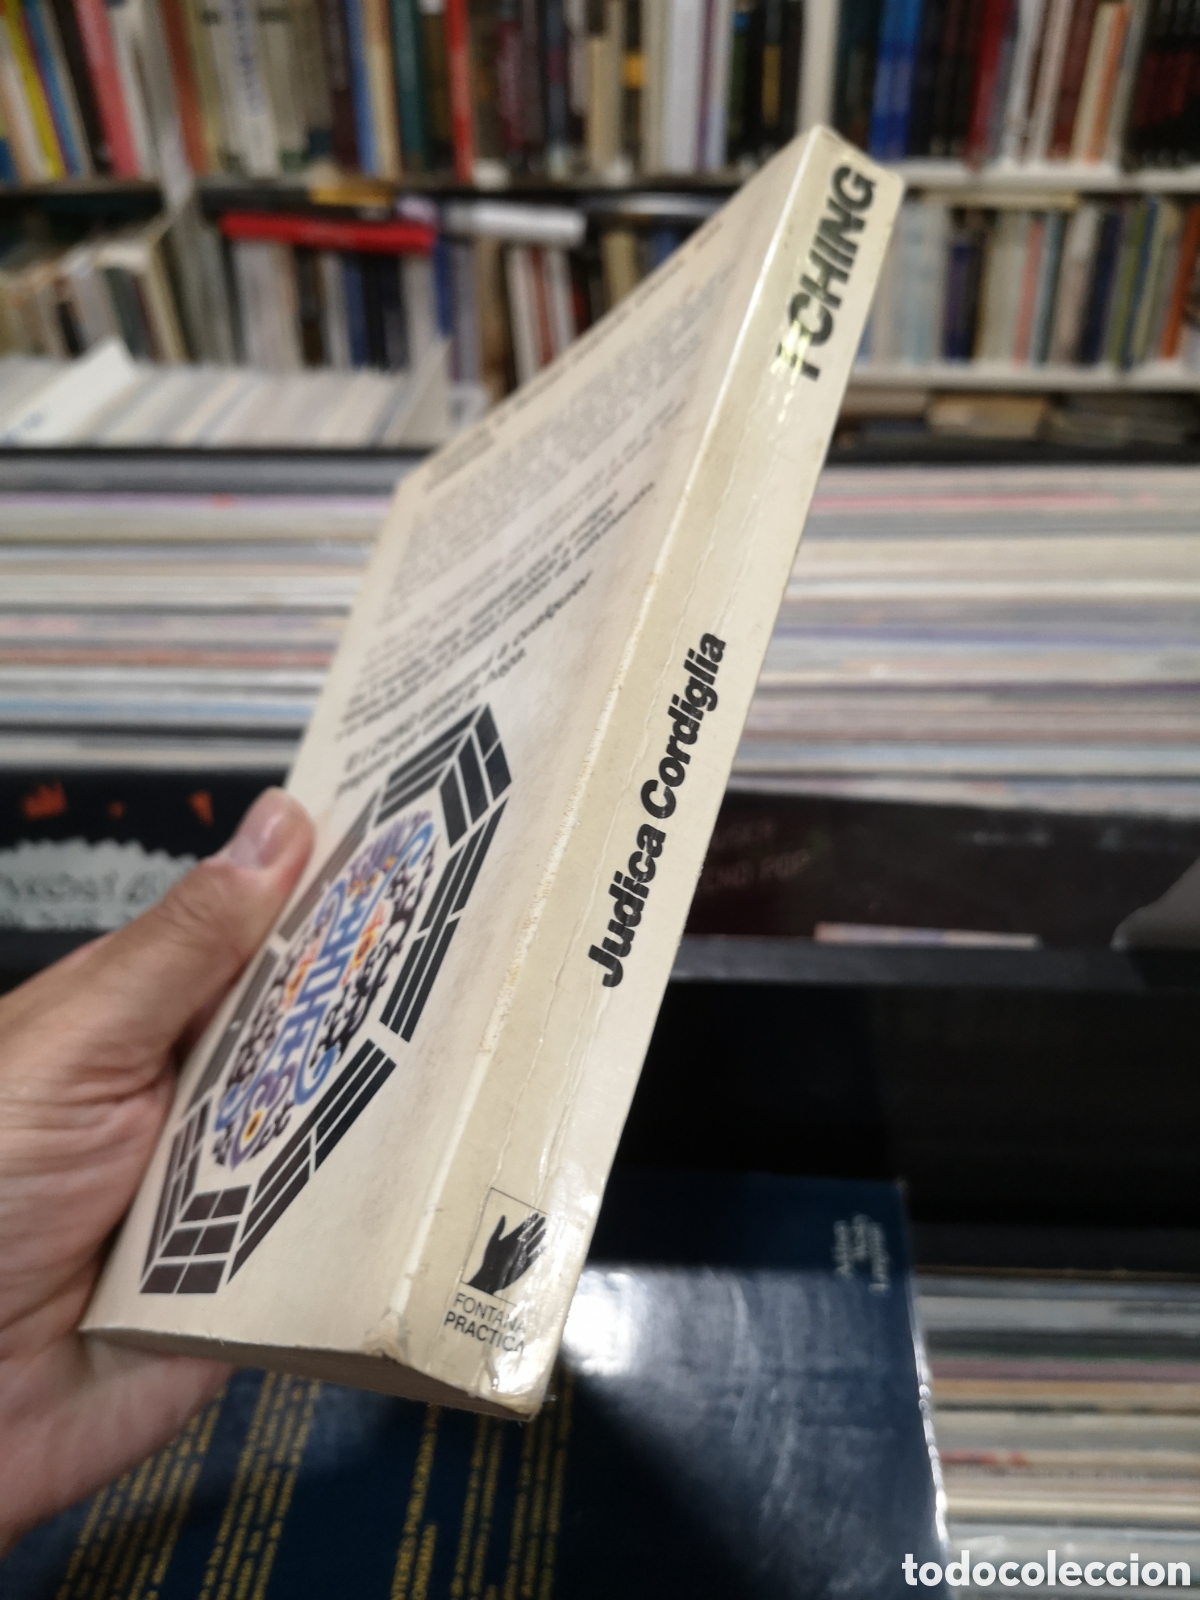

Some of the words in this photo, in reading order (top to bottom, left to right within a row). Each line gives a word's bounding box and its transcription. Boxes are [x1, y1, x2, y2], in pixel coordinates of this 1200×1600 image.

[788, 164, 876, 346] CHING
[587, 823, 666, 988] Judica
[640, 632, 727, 820] Cordiglia
